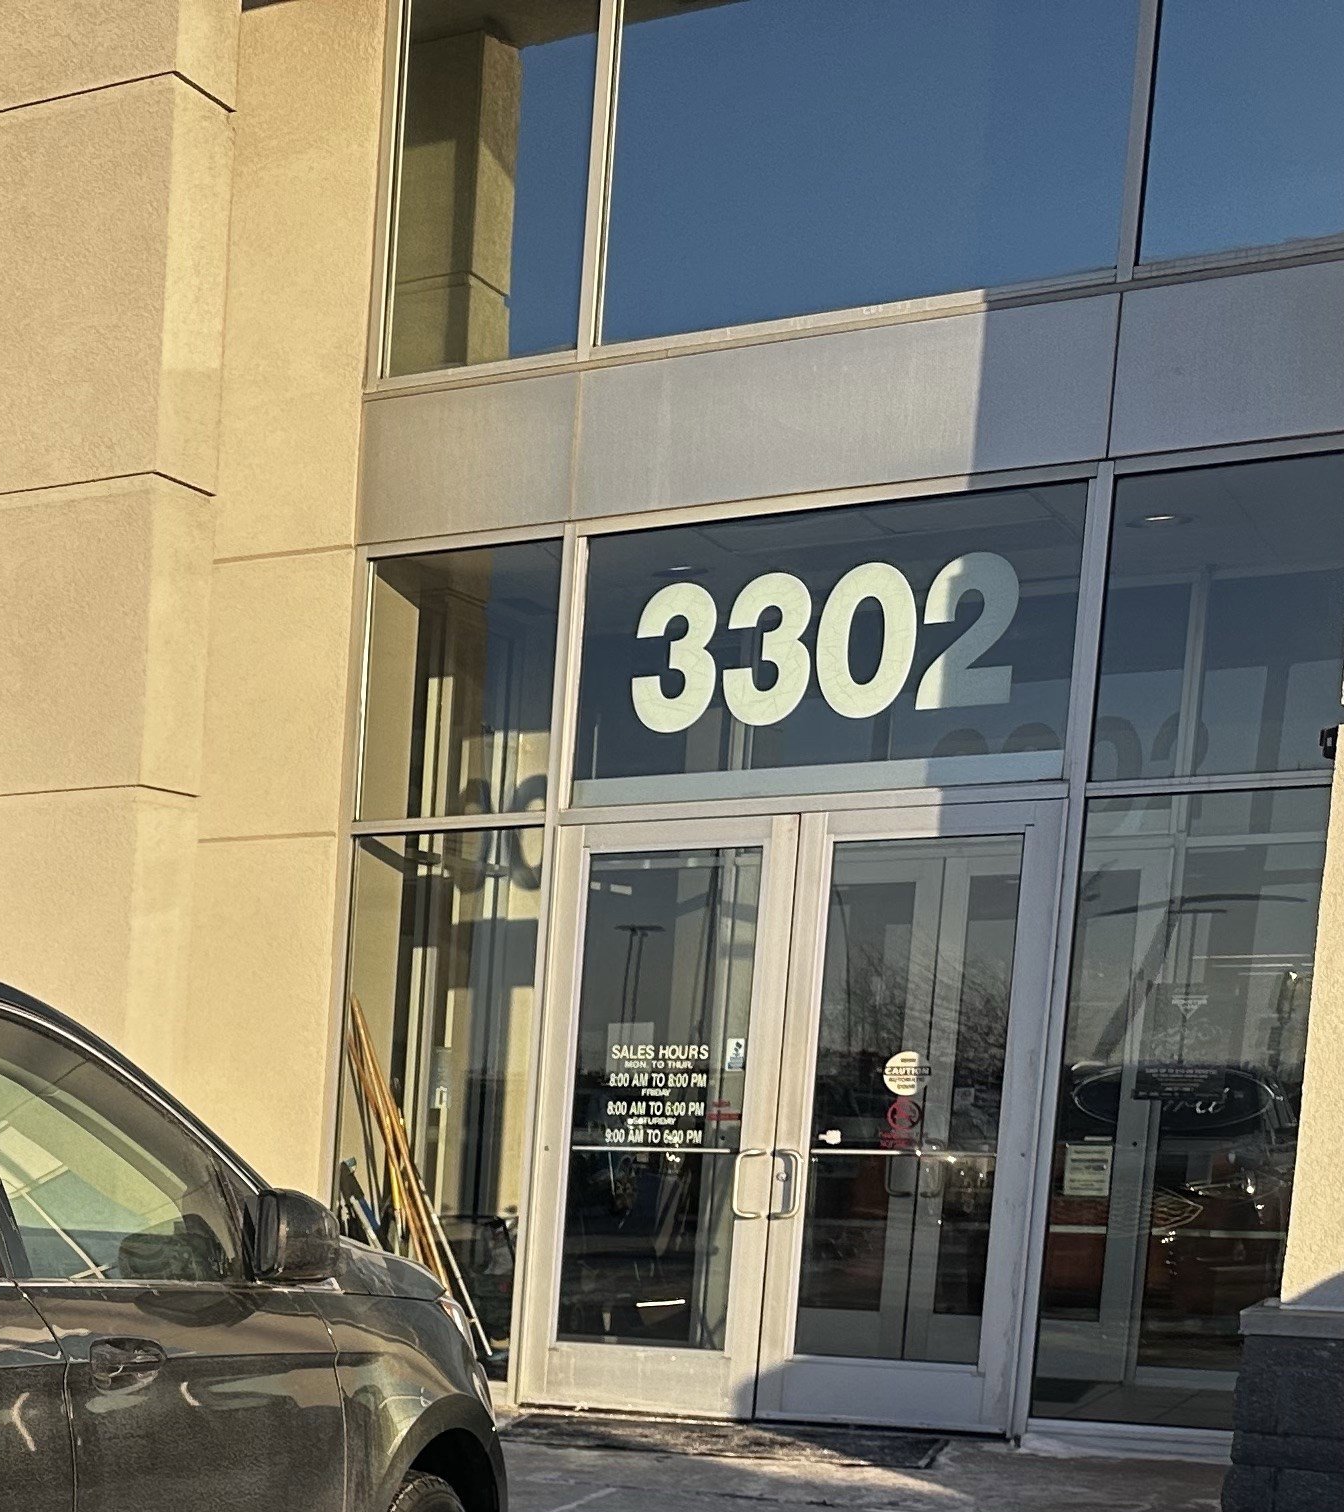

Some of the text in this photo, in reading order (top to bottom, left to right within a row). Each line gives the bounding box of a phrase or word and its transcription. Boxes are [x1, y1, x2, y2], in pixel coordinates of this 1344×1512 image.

[631, 551, 1020, 734] 3302
[612, 1044, 709, 1060] SALES HOURS
[652, 1060, 665, 1069] TO
[884, 1066, 930, 1075] CAUTION
[609, 1072, 630, 1087] 8:00
[631, 1072, 649, 1087] AM
[651, 1072, 666, 1088] TO
[690, 1072, 708, 1088] PM
[641, 1088, 672, 1097] FRIDAY
[606, 1100, 628, 1116] 8:00
[629, 1100, 647, 1116] AM
[648, 1100, 664, 1116] TO
[664, 1101, 687, 1117] 6:00
[688, 1101, 705, 1117] PM
[632, 1116, 677, 1125] SATURDAY
[604, 1128, 626, 1143] 9:00
[627, 1128, 644, 1144] AM
[646, 1128, 661, 1144] TO
[686, 1129, 703, 1145] PM
